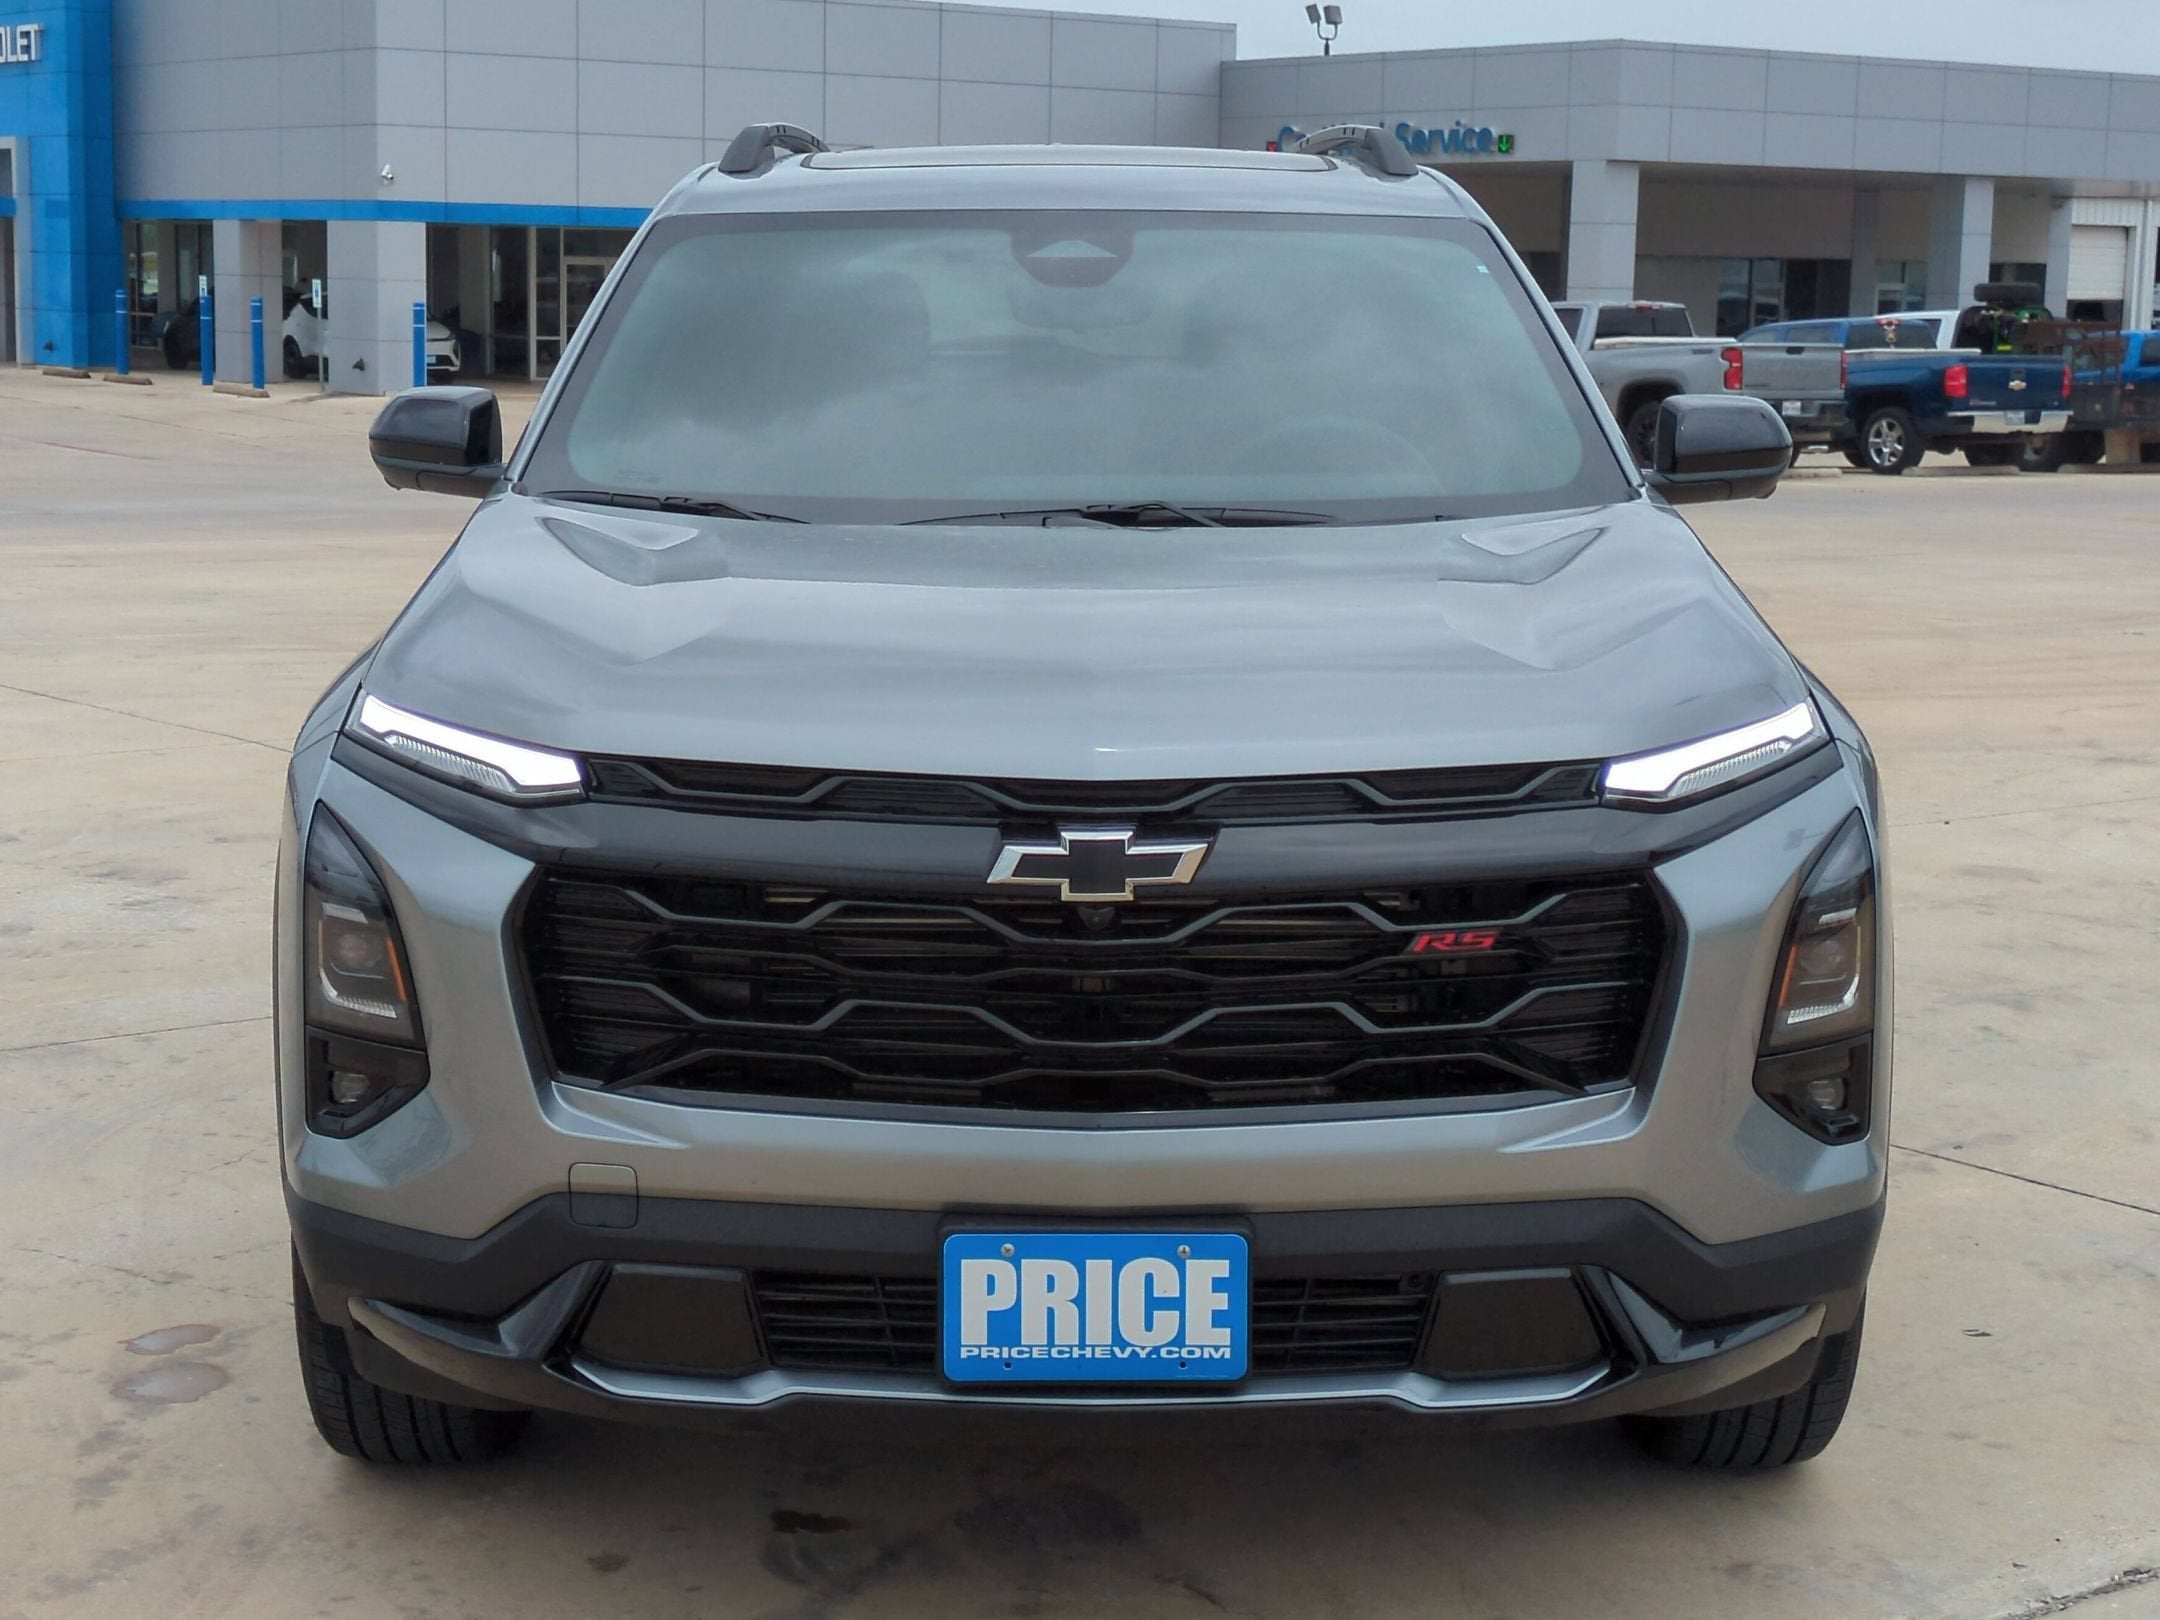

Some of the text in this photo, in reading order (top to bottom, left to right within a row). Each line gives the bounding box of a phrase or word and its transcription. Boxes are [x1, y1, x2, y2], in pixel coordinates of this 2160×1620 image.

[1396, 120, 1493, 154] Service
[1413, 931, 1497, 953] RS
[960, 1257, 1231, 1346] PRICE
[960, 1346, 1231, 1359] PRICECHEVY.COM
